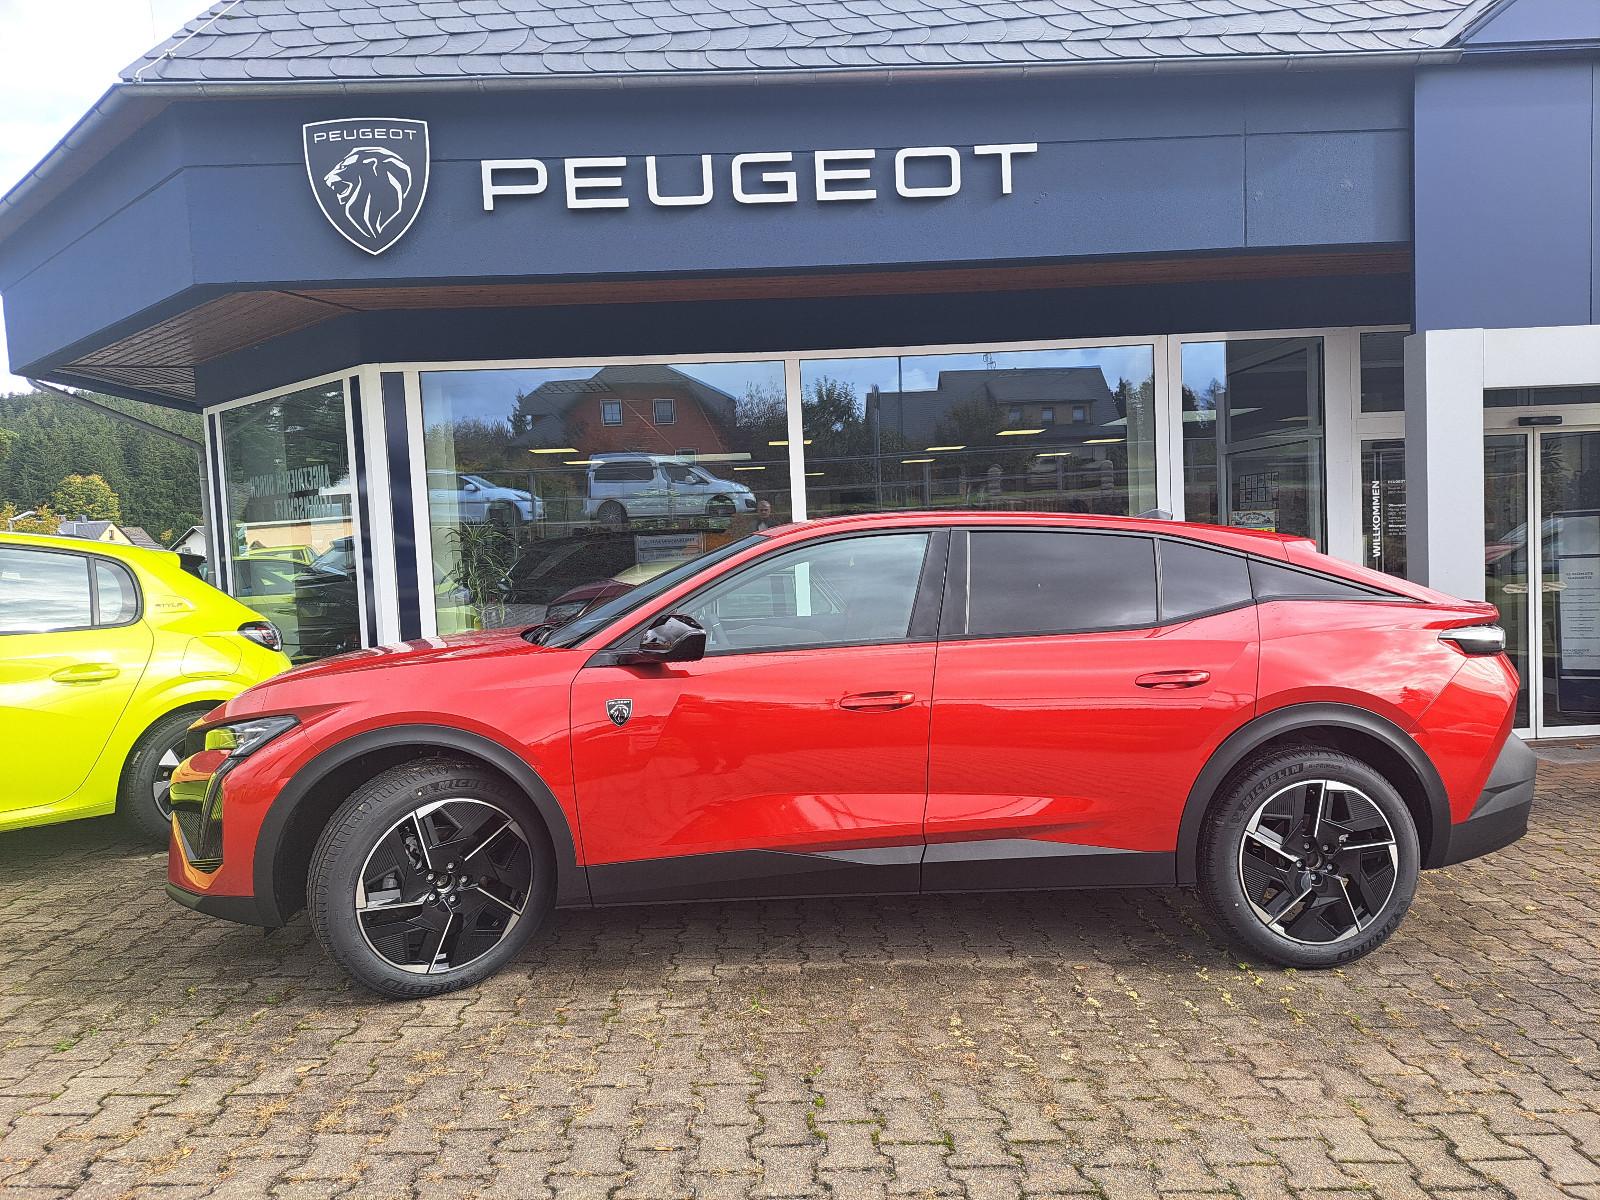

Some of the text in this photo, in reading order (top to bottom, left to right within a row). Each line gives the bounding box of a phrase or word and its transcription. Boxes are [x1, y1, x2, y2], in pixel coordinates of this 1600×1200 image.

[313, 127, 417, 143] PEUGEOT
[480, 142, 1038, 211] PEUGEOT
[1372, 480, 1382, 558] WILLKOMMEN
[1241, 763, 1304, 809] MICHELIN
